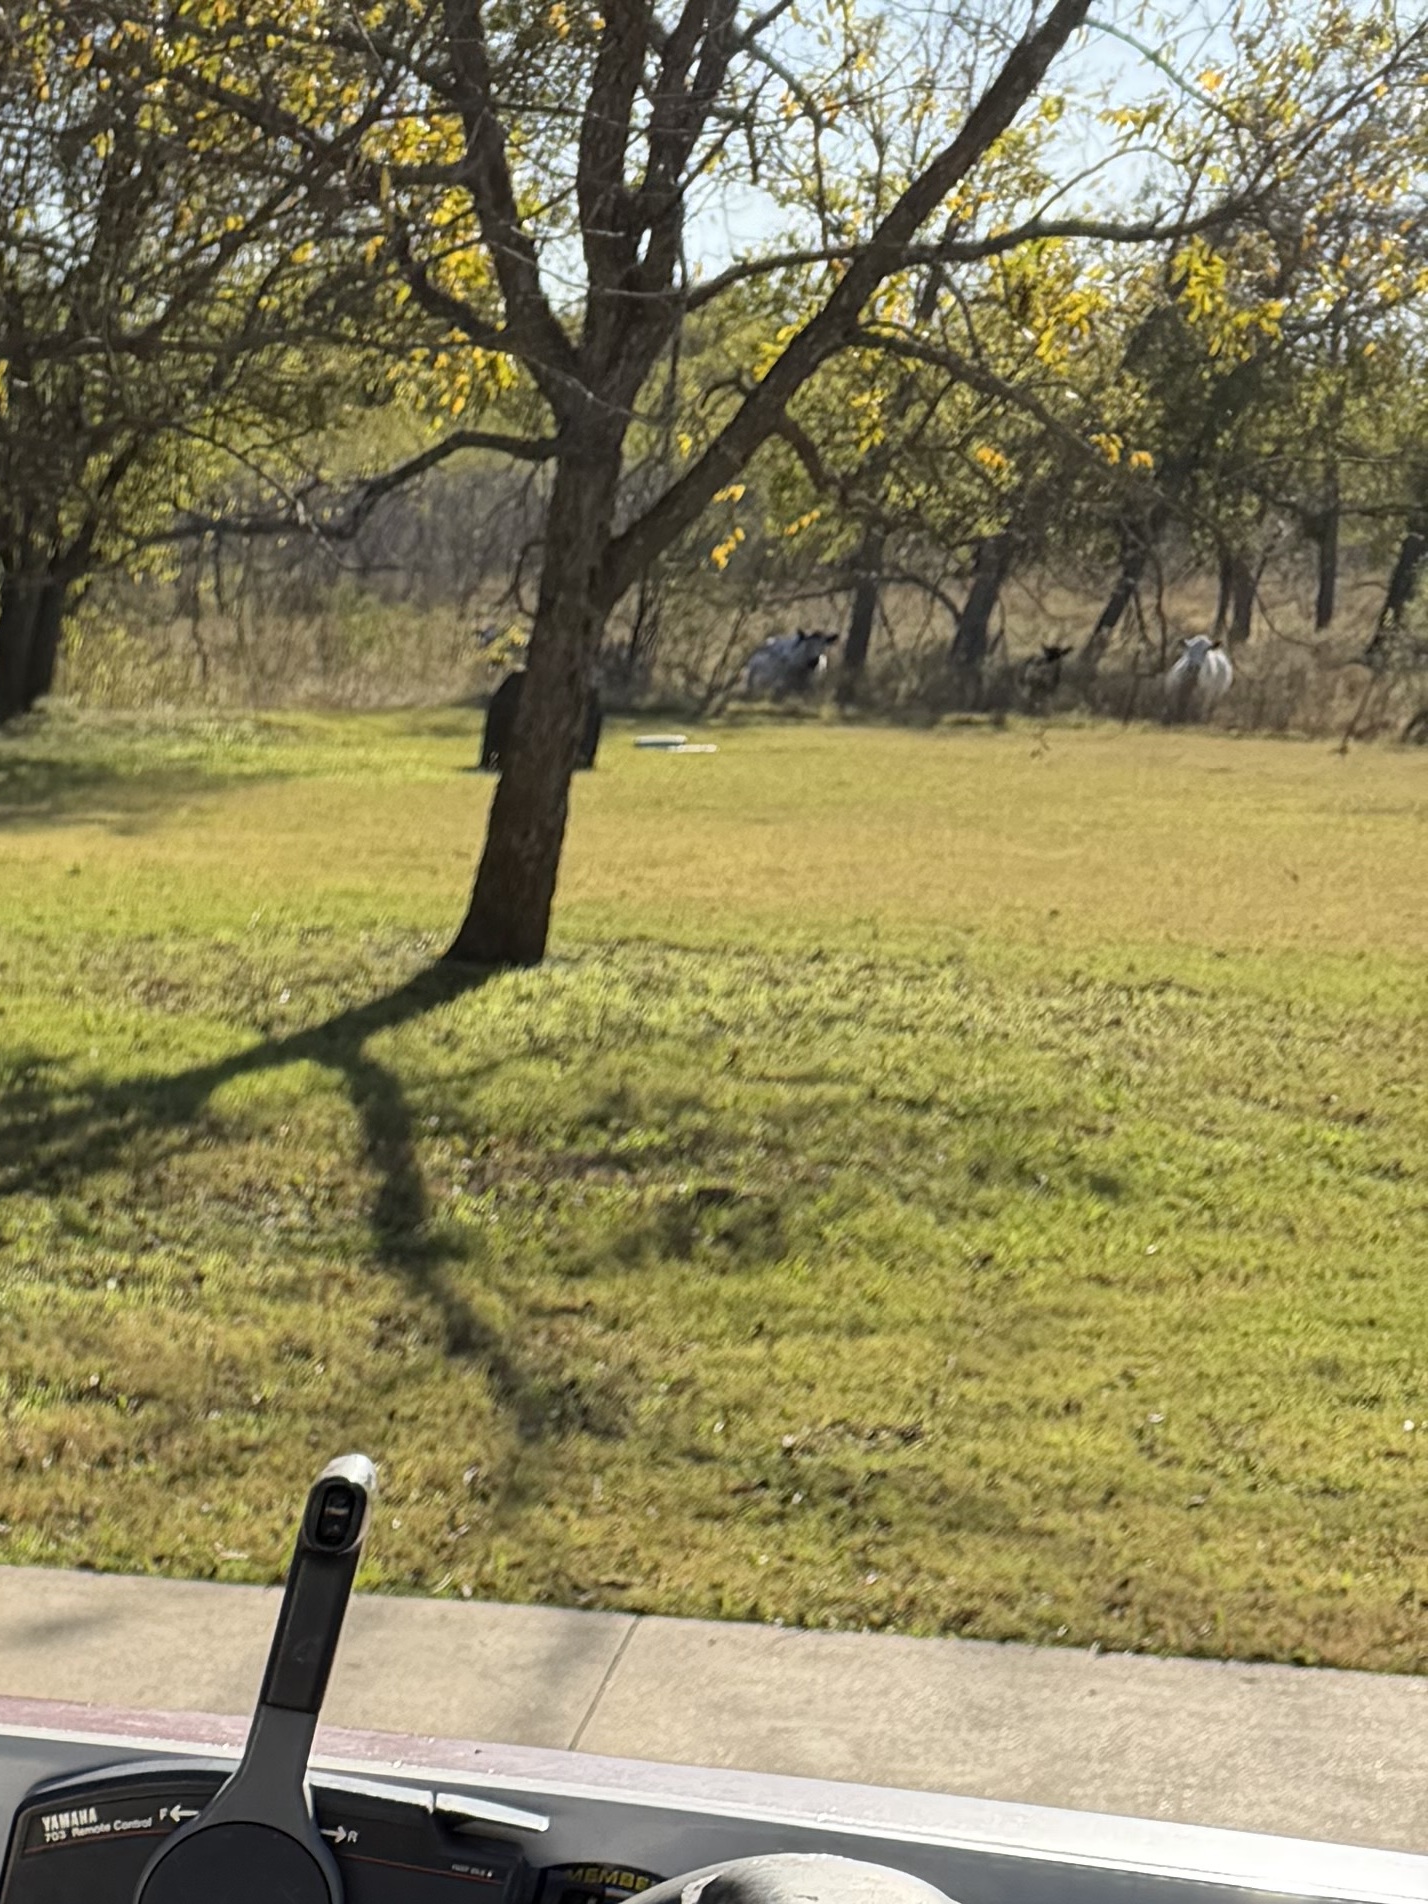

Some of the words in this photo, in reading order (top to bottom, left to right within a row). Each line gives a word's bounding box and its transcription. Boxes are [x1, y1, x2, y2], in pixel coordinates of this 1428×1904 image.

[42, 1807, 97, 1832] YAMAHA
[159, 1807, 168, 1821] F
[45, 1831, 67, 1843] 703
[72, 1823, 111, 1838] Remote
[113, 1816, 153, 1832] Control
[347, 1829, 358, 1843] R
[566, 1867, 656, 1893] MEMBE
